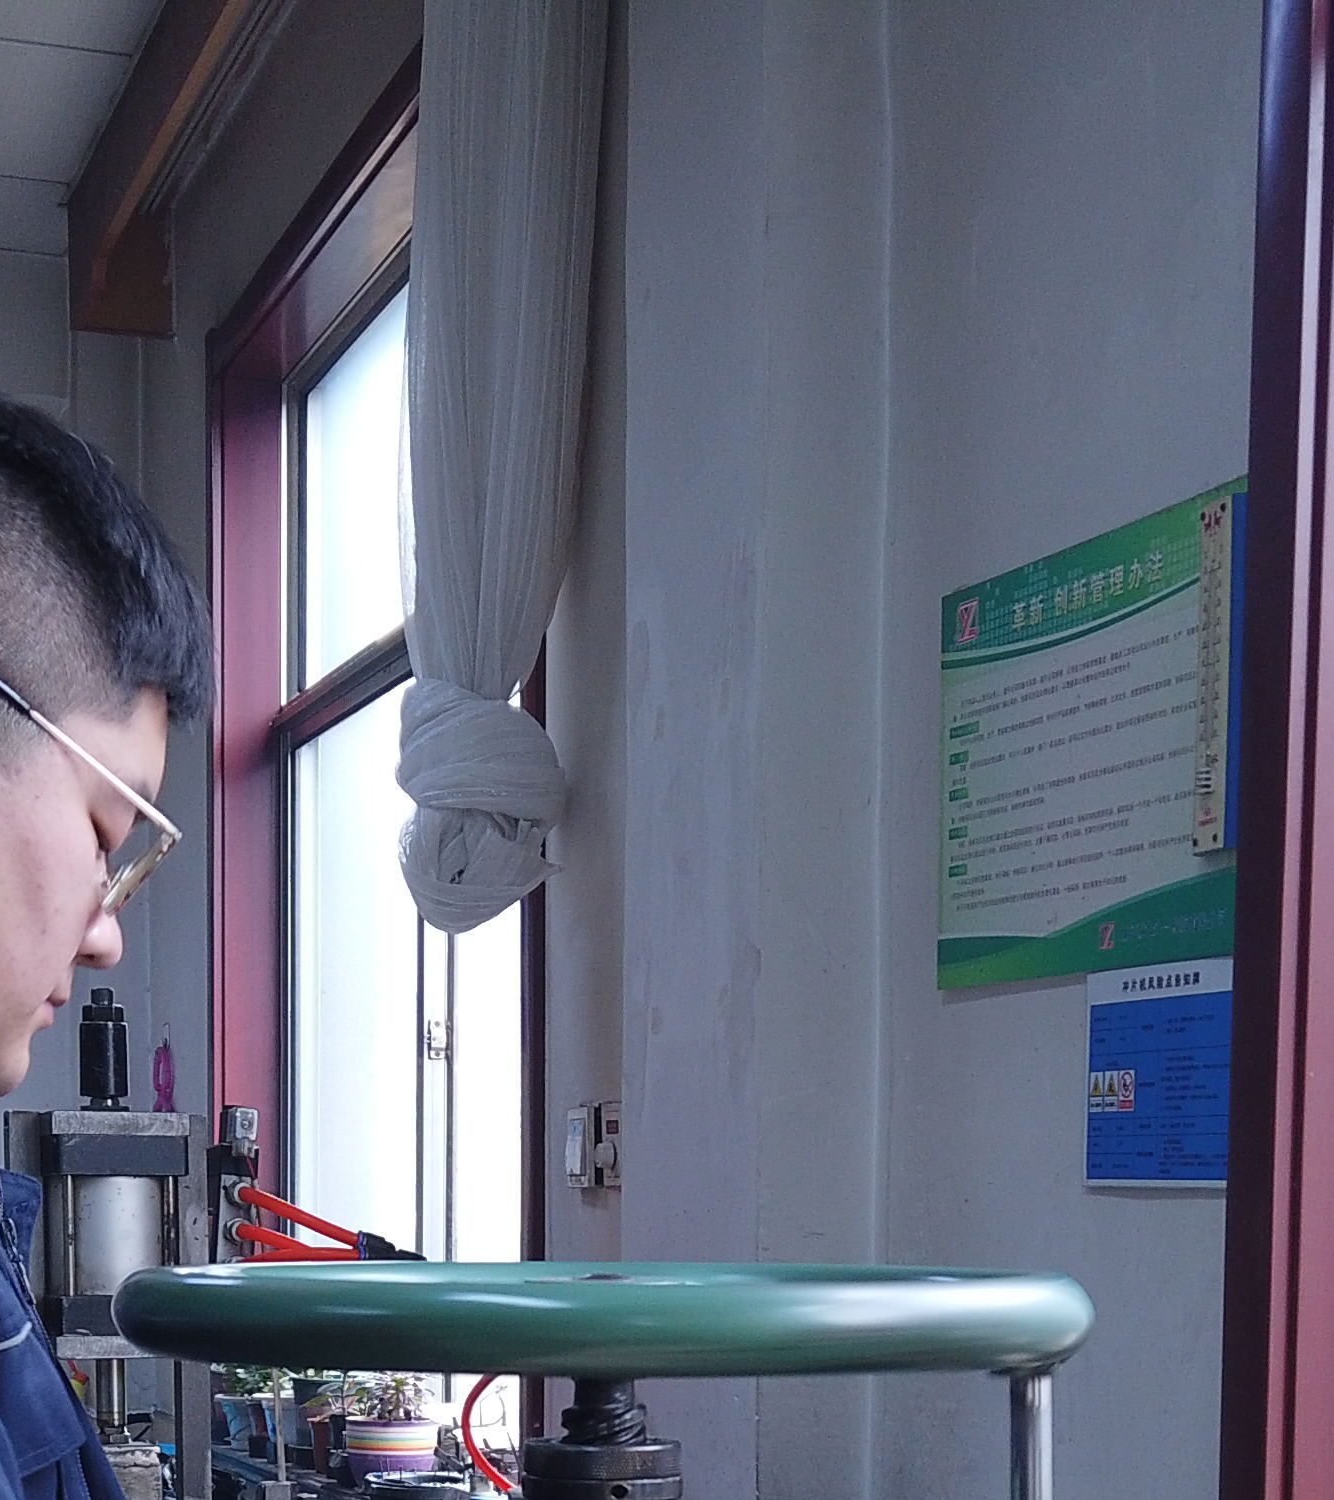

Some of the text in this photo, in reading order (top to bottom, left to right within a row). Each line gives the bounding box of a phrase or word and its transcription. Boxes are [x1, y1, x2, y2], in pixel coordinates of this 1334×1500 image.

[1054, 549, 1165, 616] 创新管理办法
